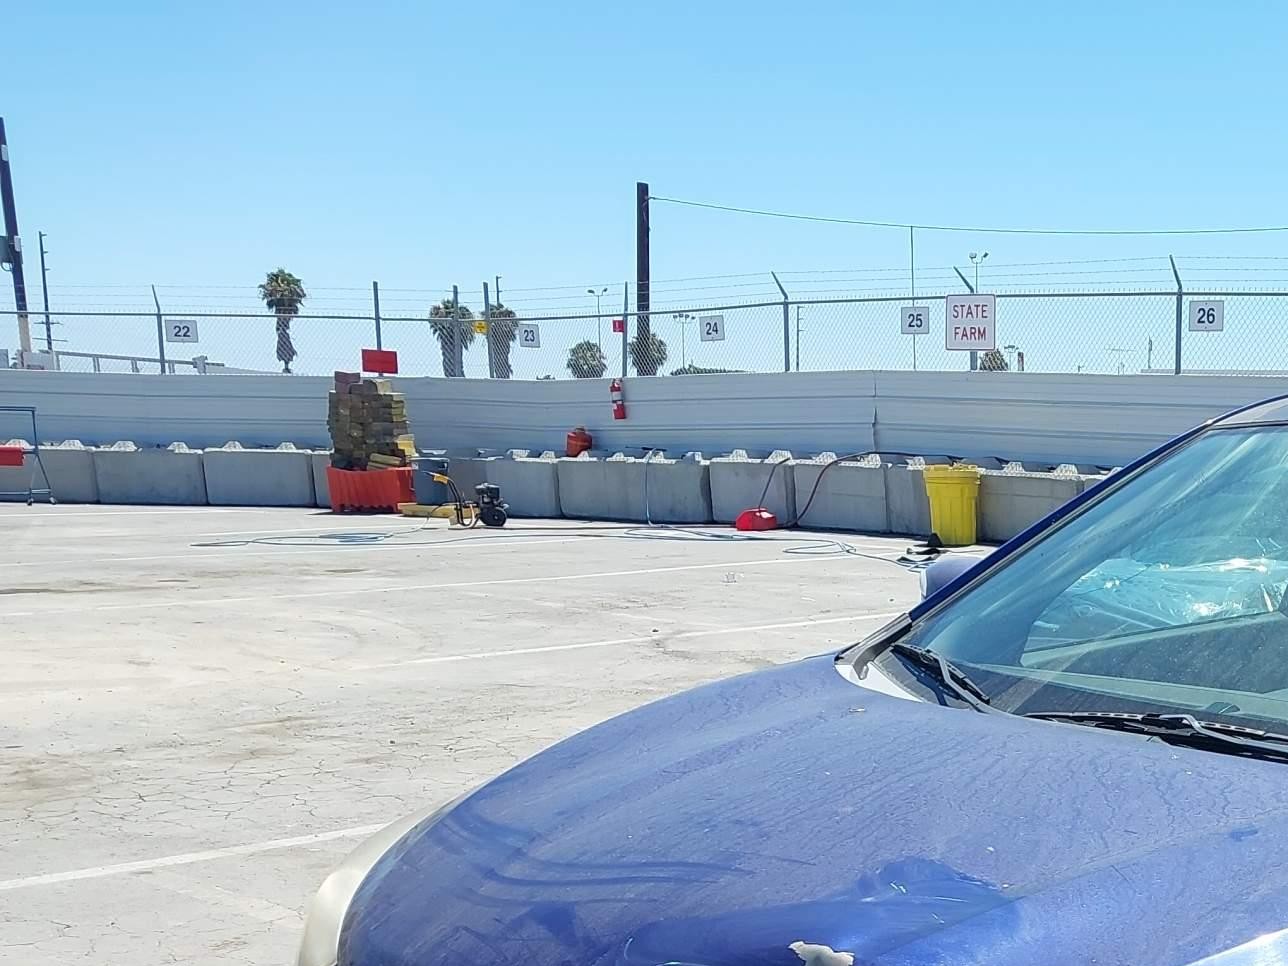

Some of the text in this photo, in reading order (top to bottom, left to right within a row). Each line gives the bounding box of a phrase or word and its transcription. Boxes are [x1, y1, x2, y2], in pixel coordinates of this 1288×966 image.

[952, 303, 988, 319] STATE
[1196, 308, 1216, 324] 26
[907, 313, 923, 328] 25
[173, 325, 191, 338] 22
[523, 329, 536, 343] 23
[705, 321, 719, 336] 24
[954, 326, 987, 341] FARM
